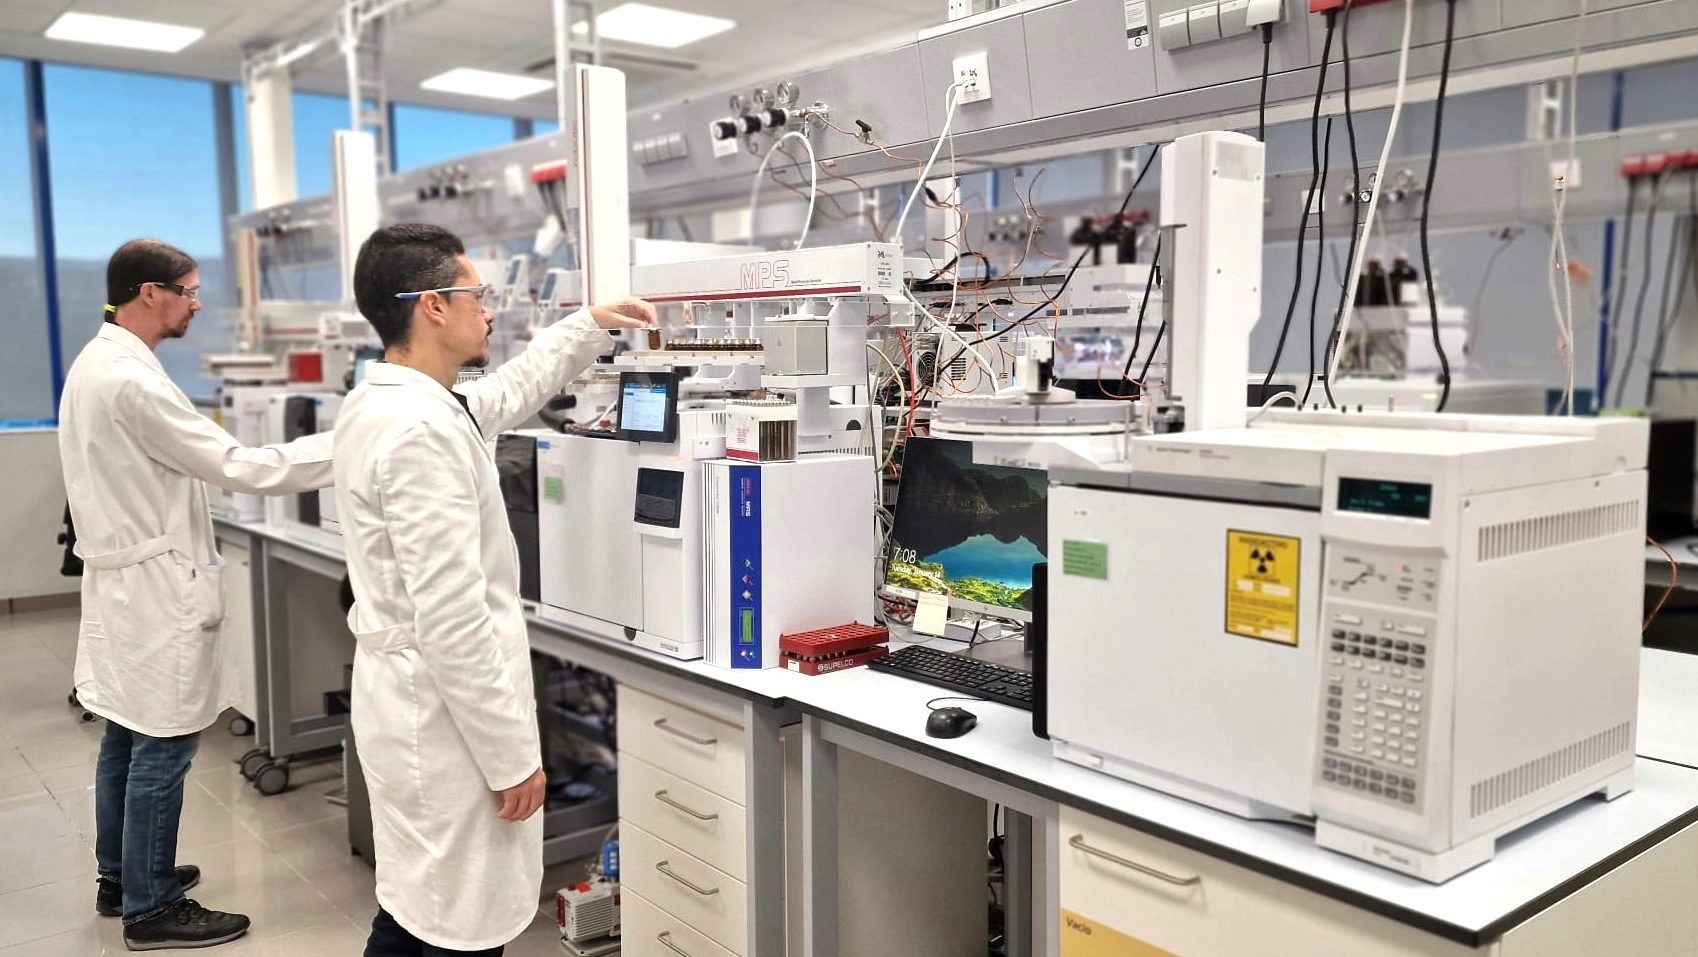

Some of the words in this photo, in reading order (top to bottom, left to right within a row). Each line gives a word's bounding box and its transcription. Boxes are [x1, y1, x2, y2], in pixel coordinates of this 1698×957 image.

[740, 259, 789, 290] MPS
[893, 547, 917, 563] 7:08
[823, 658, 854, 671] SUPELCO
